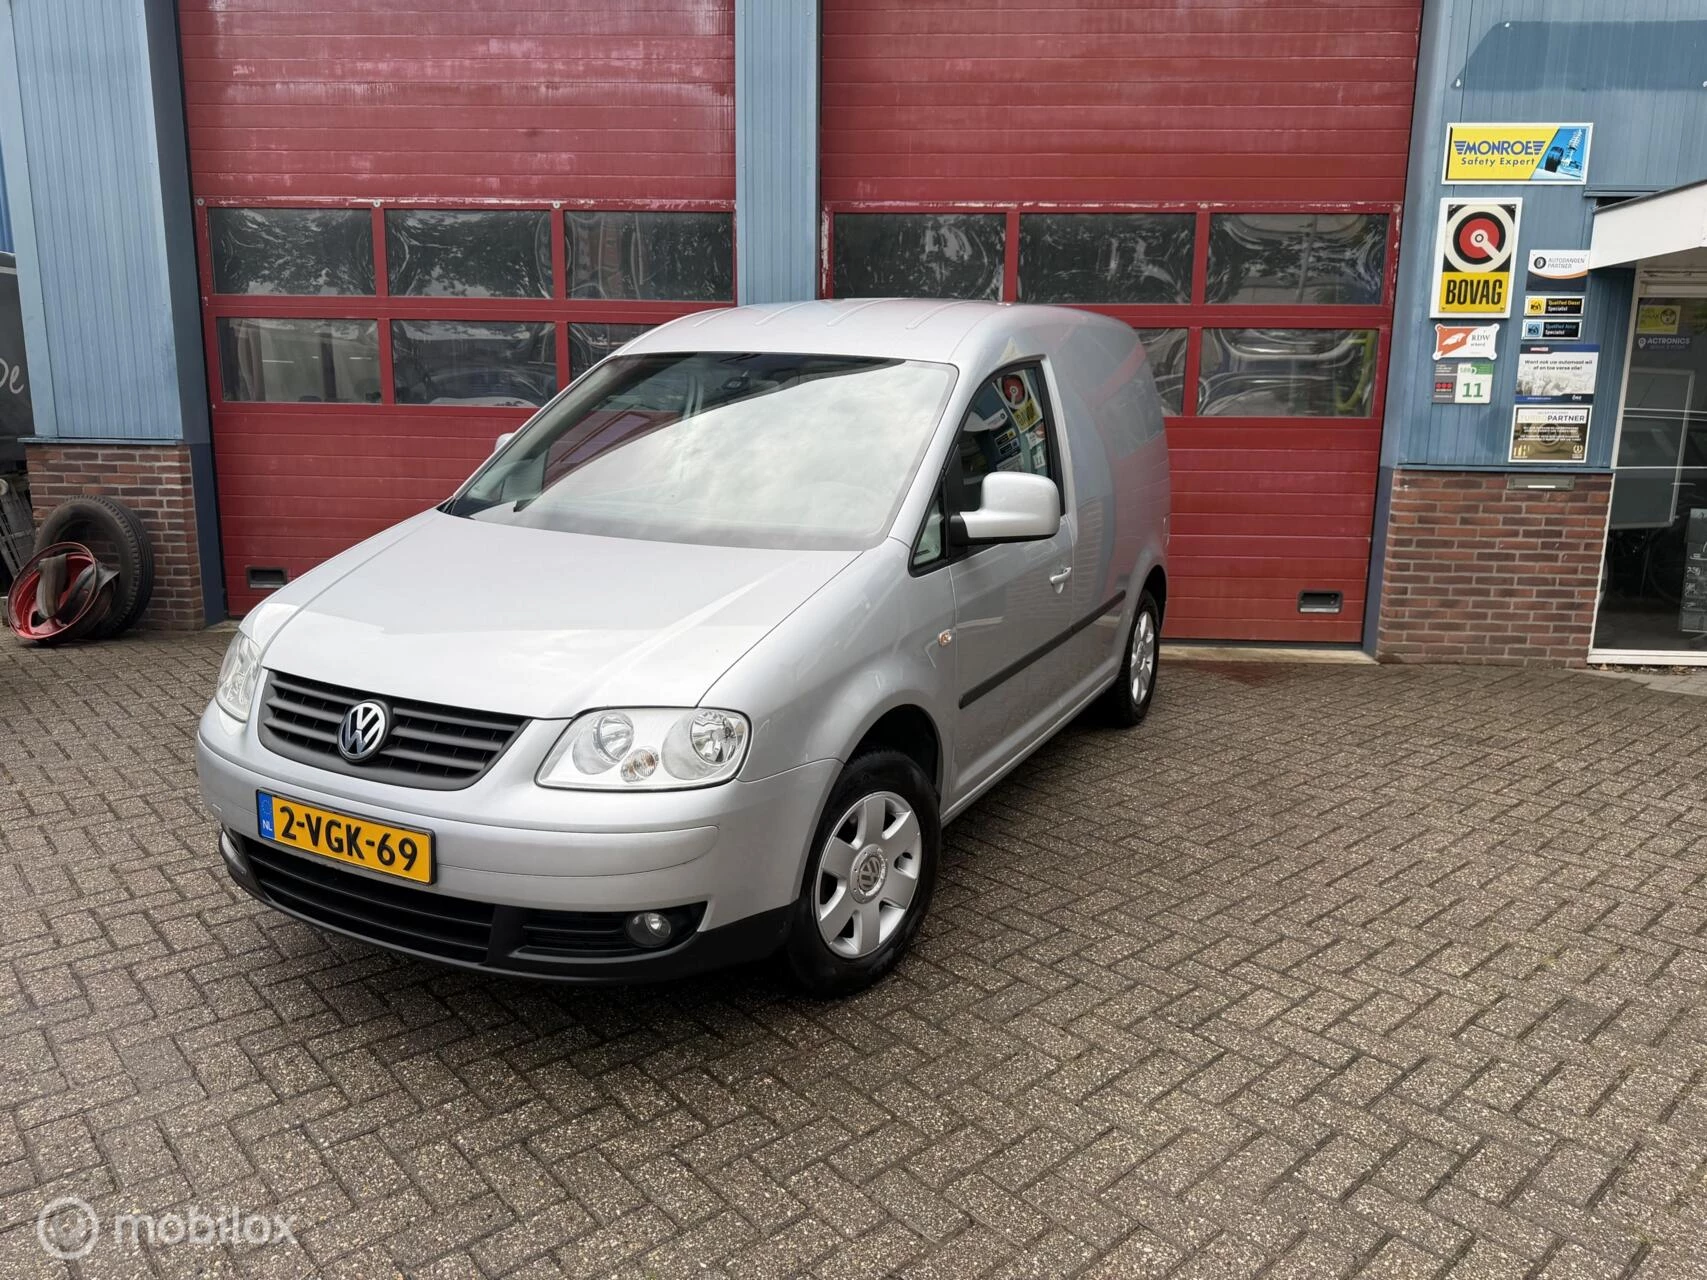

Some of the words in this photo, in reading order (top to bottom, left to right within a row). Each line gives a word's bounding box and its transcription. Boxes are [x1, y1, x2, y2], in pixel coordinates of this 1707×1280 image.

[1464, 141, 1534, 156] MONROE
[1461, 157, 1496, 167] Safety
[1500, 157, 1535, 167] Expert
[1445, 279, 1503, 305] BOVAG
[1647, 337, 1690, 345] ACTRONICS
[1462, 382, 1483, 398] 11
[262, 819, 273, 832] NL
[279, 806, 418, 872] 2-VGK-69
